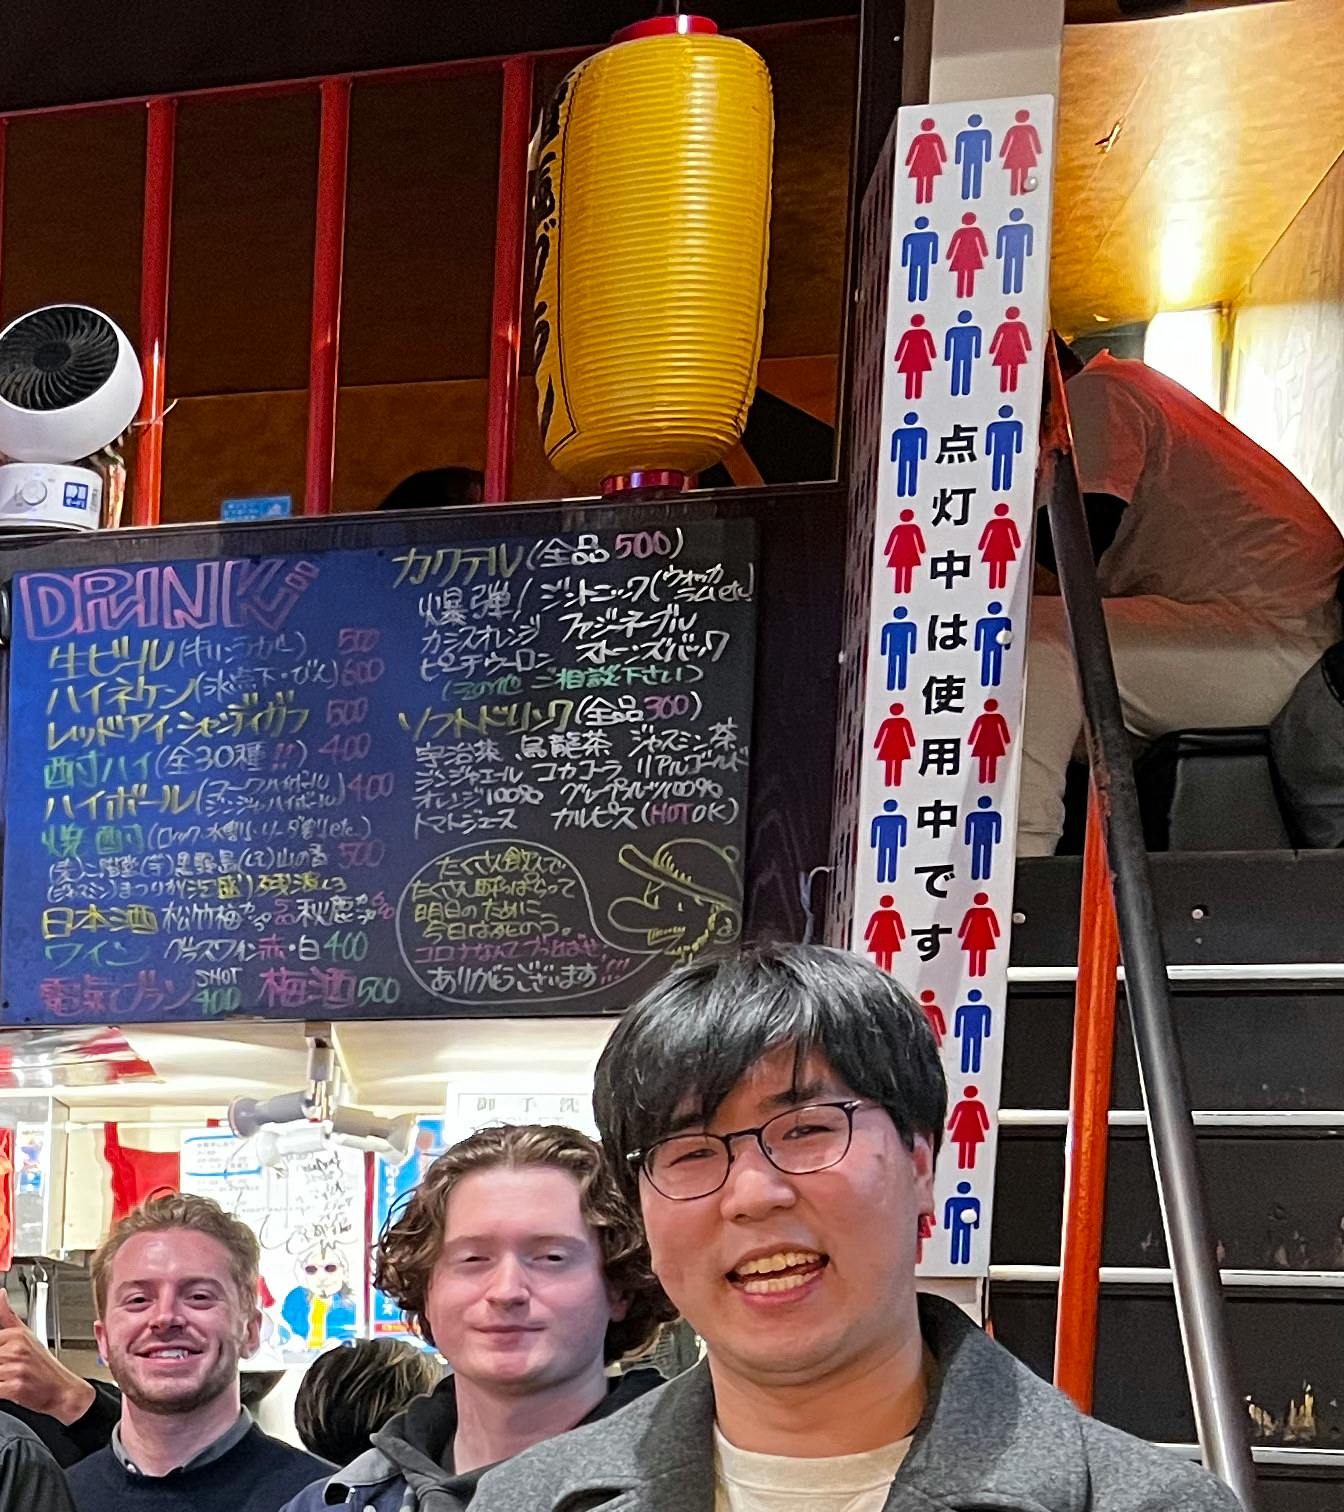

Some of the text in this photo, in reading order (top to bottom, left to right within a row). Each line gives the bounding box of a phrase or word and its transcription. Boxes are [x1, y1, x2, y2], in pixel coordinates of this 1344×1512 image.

[393, 543, 524, 588] カクテル
[420, 614, 542, 655] カシスオレンジ
[48, 635, 174, 683] 生ビール
[340, 659, 385, 687] 600
[911, 424, 979, 961] 点灯中は使用中です
[399, 700, 574, 741] ソフトドリンク
[348, 772, 395, 799] 400
[551, 803, 639, 831] カルピス
[42, 904, 159, 939] 日本酒
[44, 940, 148, 970] ワイン
[323, 929, 369, 961] 400
[196, 967, 244, 988] SHOT
[259, 966, 359, 1009] 梅酒
[357, 977, 402, 1006] 500
